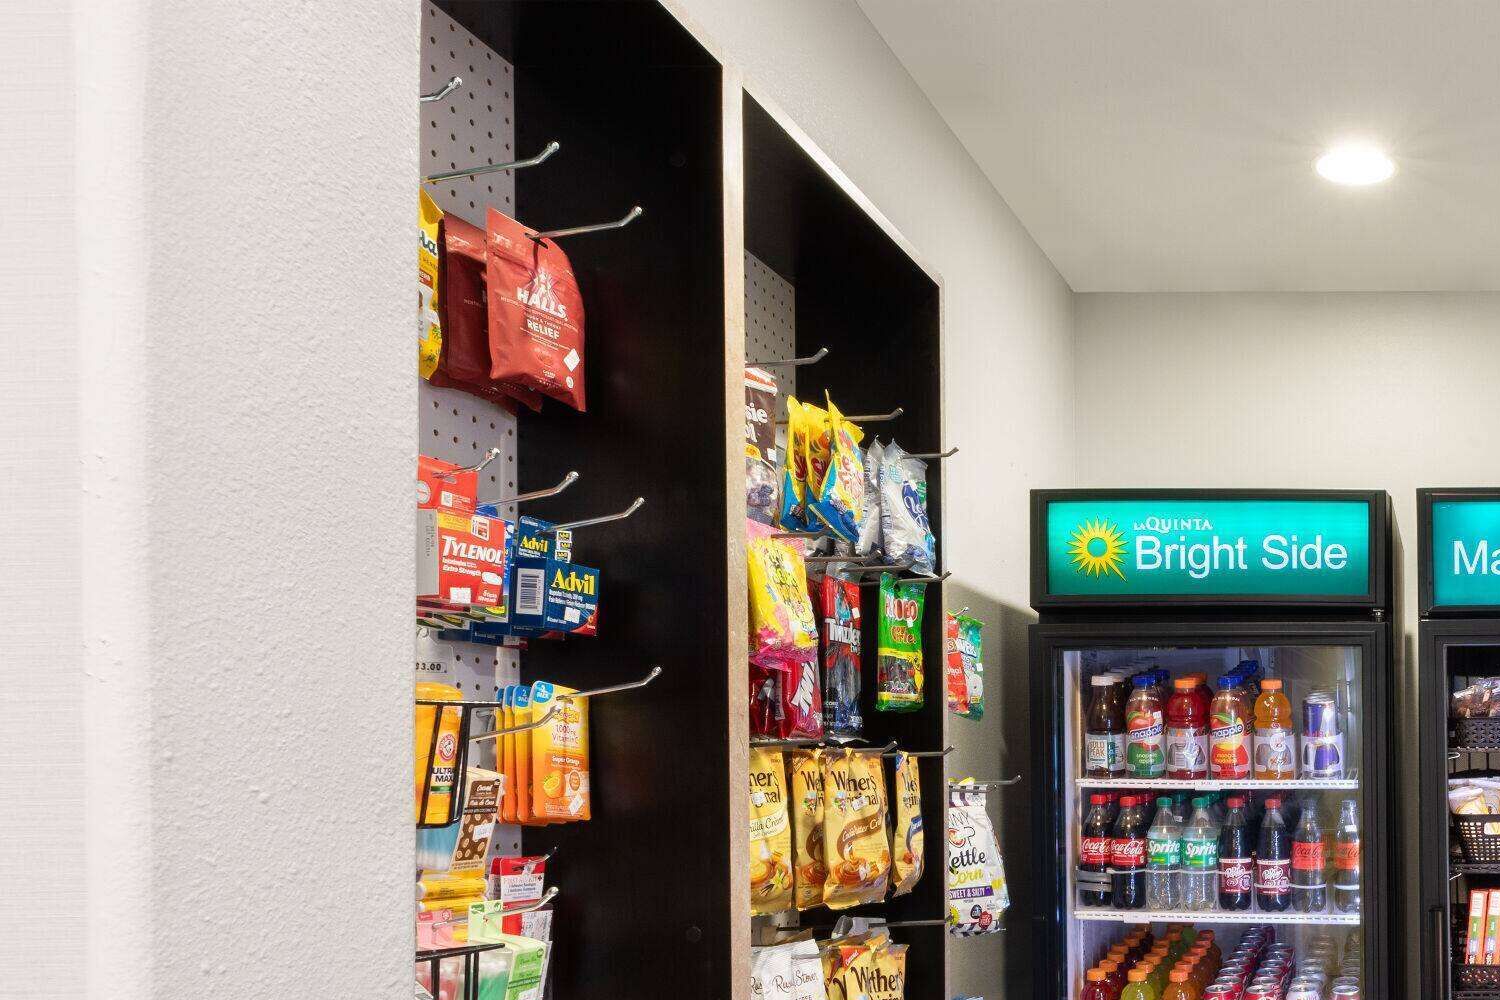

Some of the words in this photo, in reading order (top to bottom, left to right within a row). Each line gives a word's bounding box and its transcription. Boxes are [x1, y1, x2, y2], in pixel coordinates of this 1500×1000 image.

[517, 286, 568, 320] HALLS
[527, 318, 560, 340] RELIEF
[441, 534, 504, 565] TYLENOL
[520, 535, 548, 553] Advil
[1135, 534, 1248, 579] Bright
[1261, 533, 1348, 570] Side
[550, 568, 595, 596] Advil
[1210, 724, 1244, 738] napple
[1148, 839, 1180, 855] Sprite
[1185, 841, 1217, 858] Sprite
[950, 849, 986, 875] ettle
